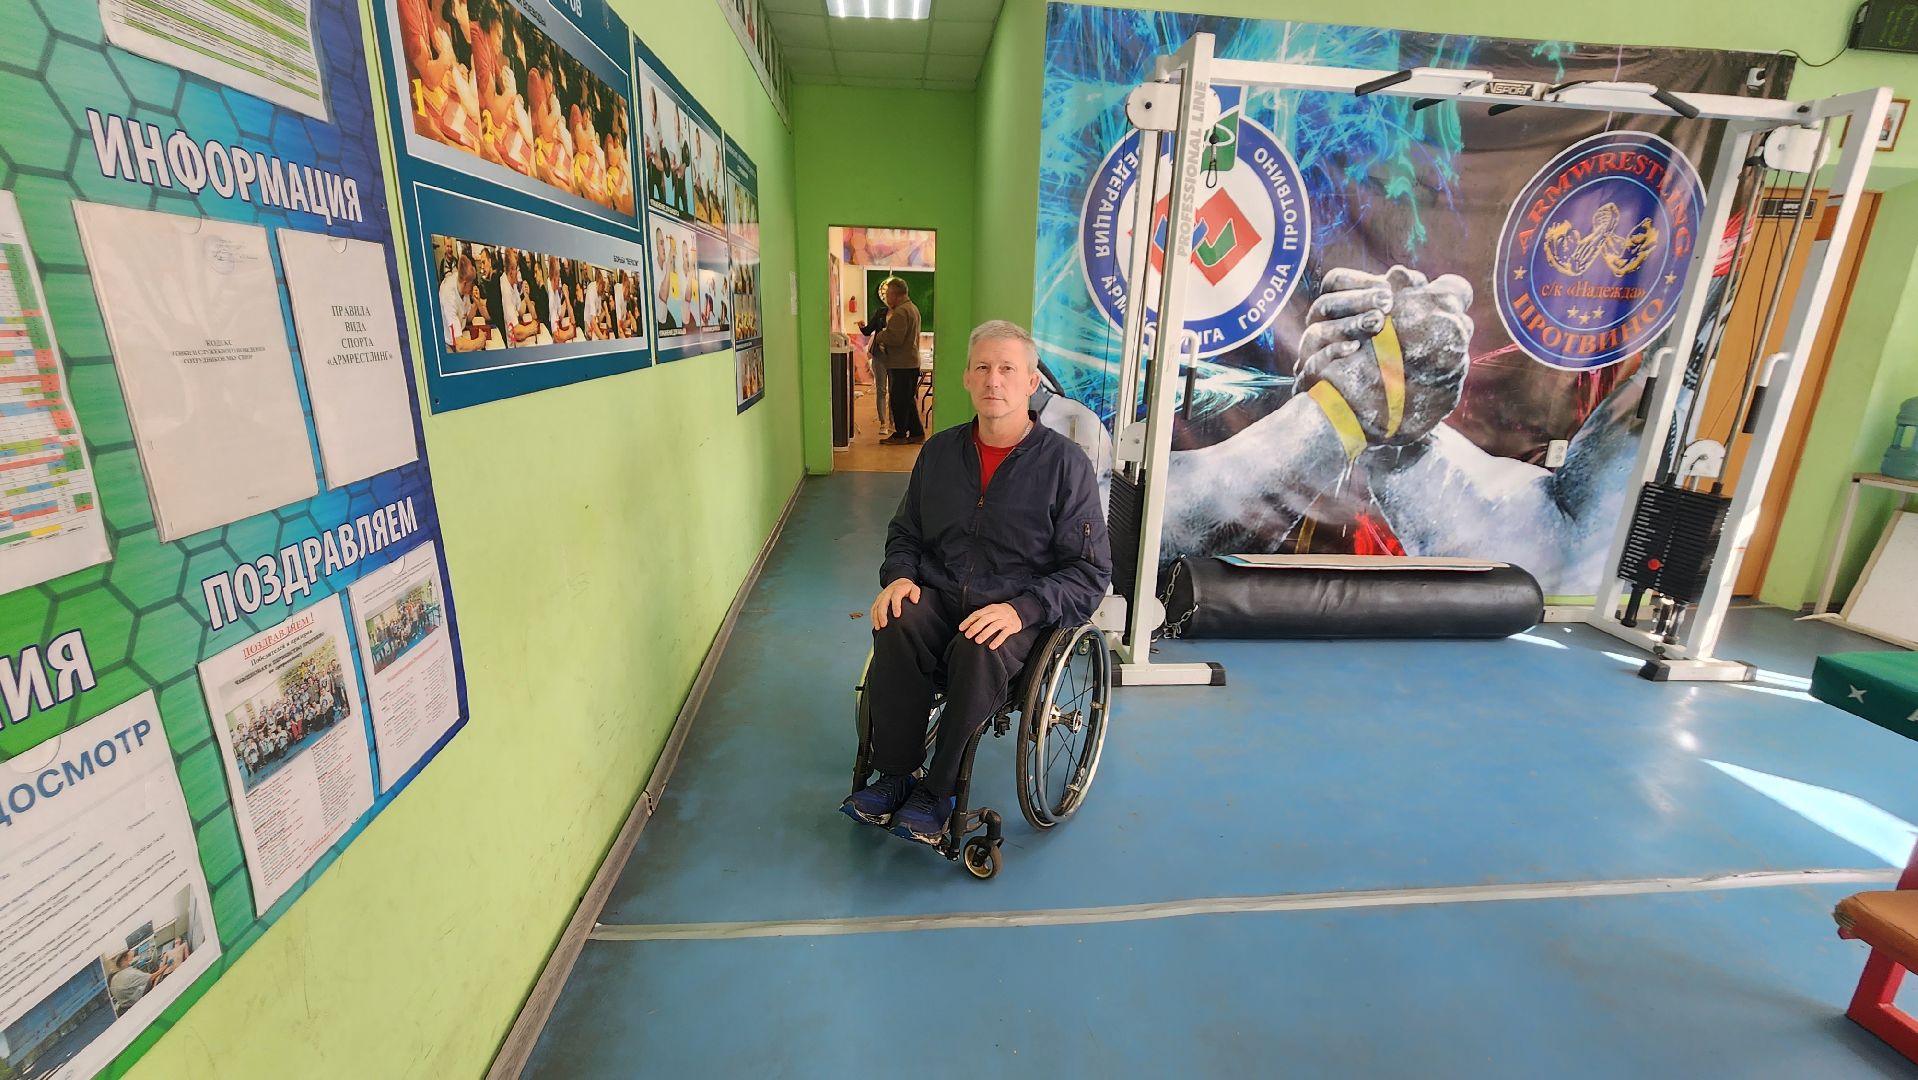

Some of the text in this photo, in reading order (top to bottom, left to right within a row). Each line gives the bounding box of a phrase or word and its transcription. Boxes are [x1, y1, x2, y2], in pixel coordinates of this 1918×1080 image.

[86, 108, 363, 226] ИНФОРМАЦИЯ
[1092, 146, 1139, 258] ЕДЕРАЦИЯ
[1177, 80, 1208, 257] PROFESSIONAL LINE
[1254, 148, 1299, 250] ПРОТВИНО
[1518, 151, 1691, 258] ARMWRESTLING
[331, 305, 372, 317] ПРАВИЛА
[341, 337, 374, 349] СПОРТА
[345, 322, 367, 333] ВИДА
[1238, 264, 1291, 330] ГОРОДА
[1513, 293, 1665, 355] ПРОТВИНО
[327, 351, 393, 366] «АРМРЕСТЛИНГ»
[201, 496, 418, 631] ПОЗДРАВЛЯЕМ
[0, 628, 97, 733] ИЯ
